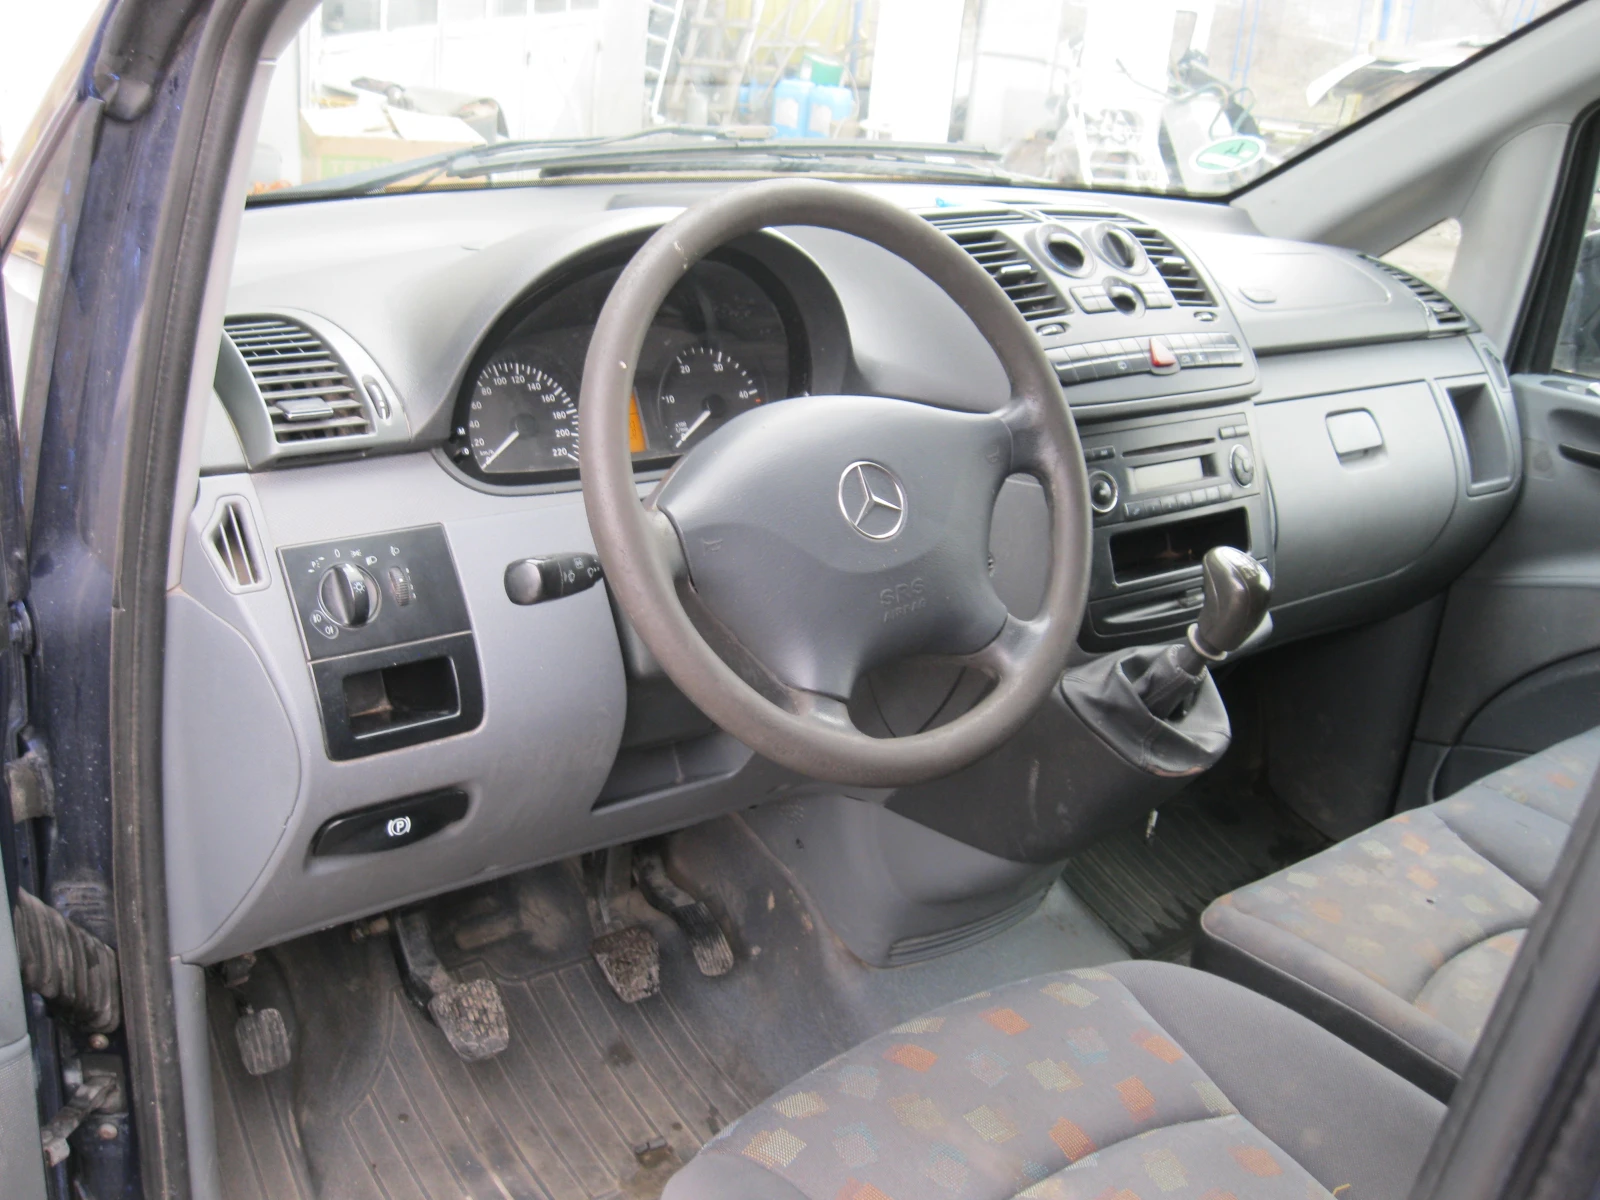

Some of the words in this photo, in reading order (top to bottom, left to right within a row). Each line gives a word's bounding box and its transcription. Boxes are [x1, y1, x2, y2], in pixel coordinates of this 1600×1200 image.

[680, 364, 691, 374] 20
[713, 363, 724, 372] 30
[493, 377, 507, 386] 100
[511, 375, 526, 384] 120
[481, 387, 492, 396] 80
[527, 383, 542, 391] 140
[541, 394, 556, 402] 160
[738, 390, 750, 399] 40
[665, 395, 676, 404] 10
[472, 401, 482, 410] 60
[553, 411, 567, 420] 180
[469, 420, 480, 429] 40
[555, 429, 570, 438] 200
[474, 438, 485, 447] 20
[552, 448, 568, 457] 220
